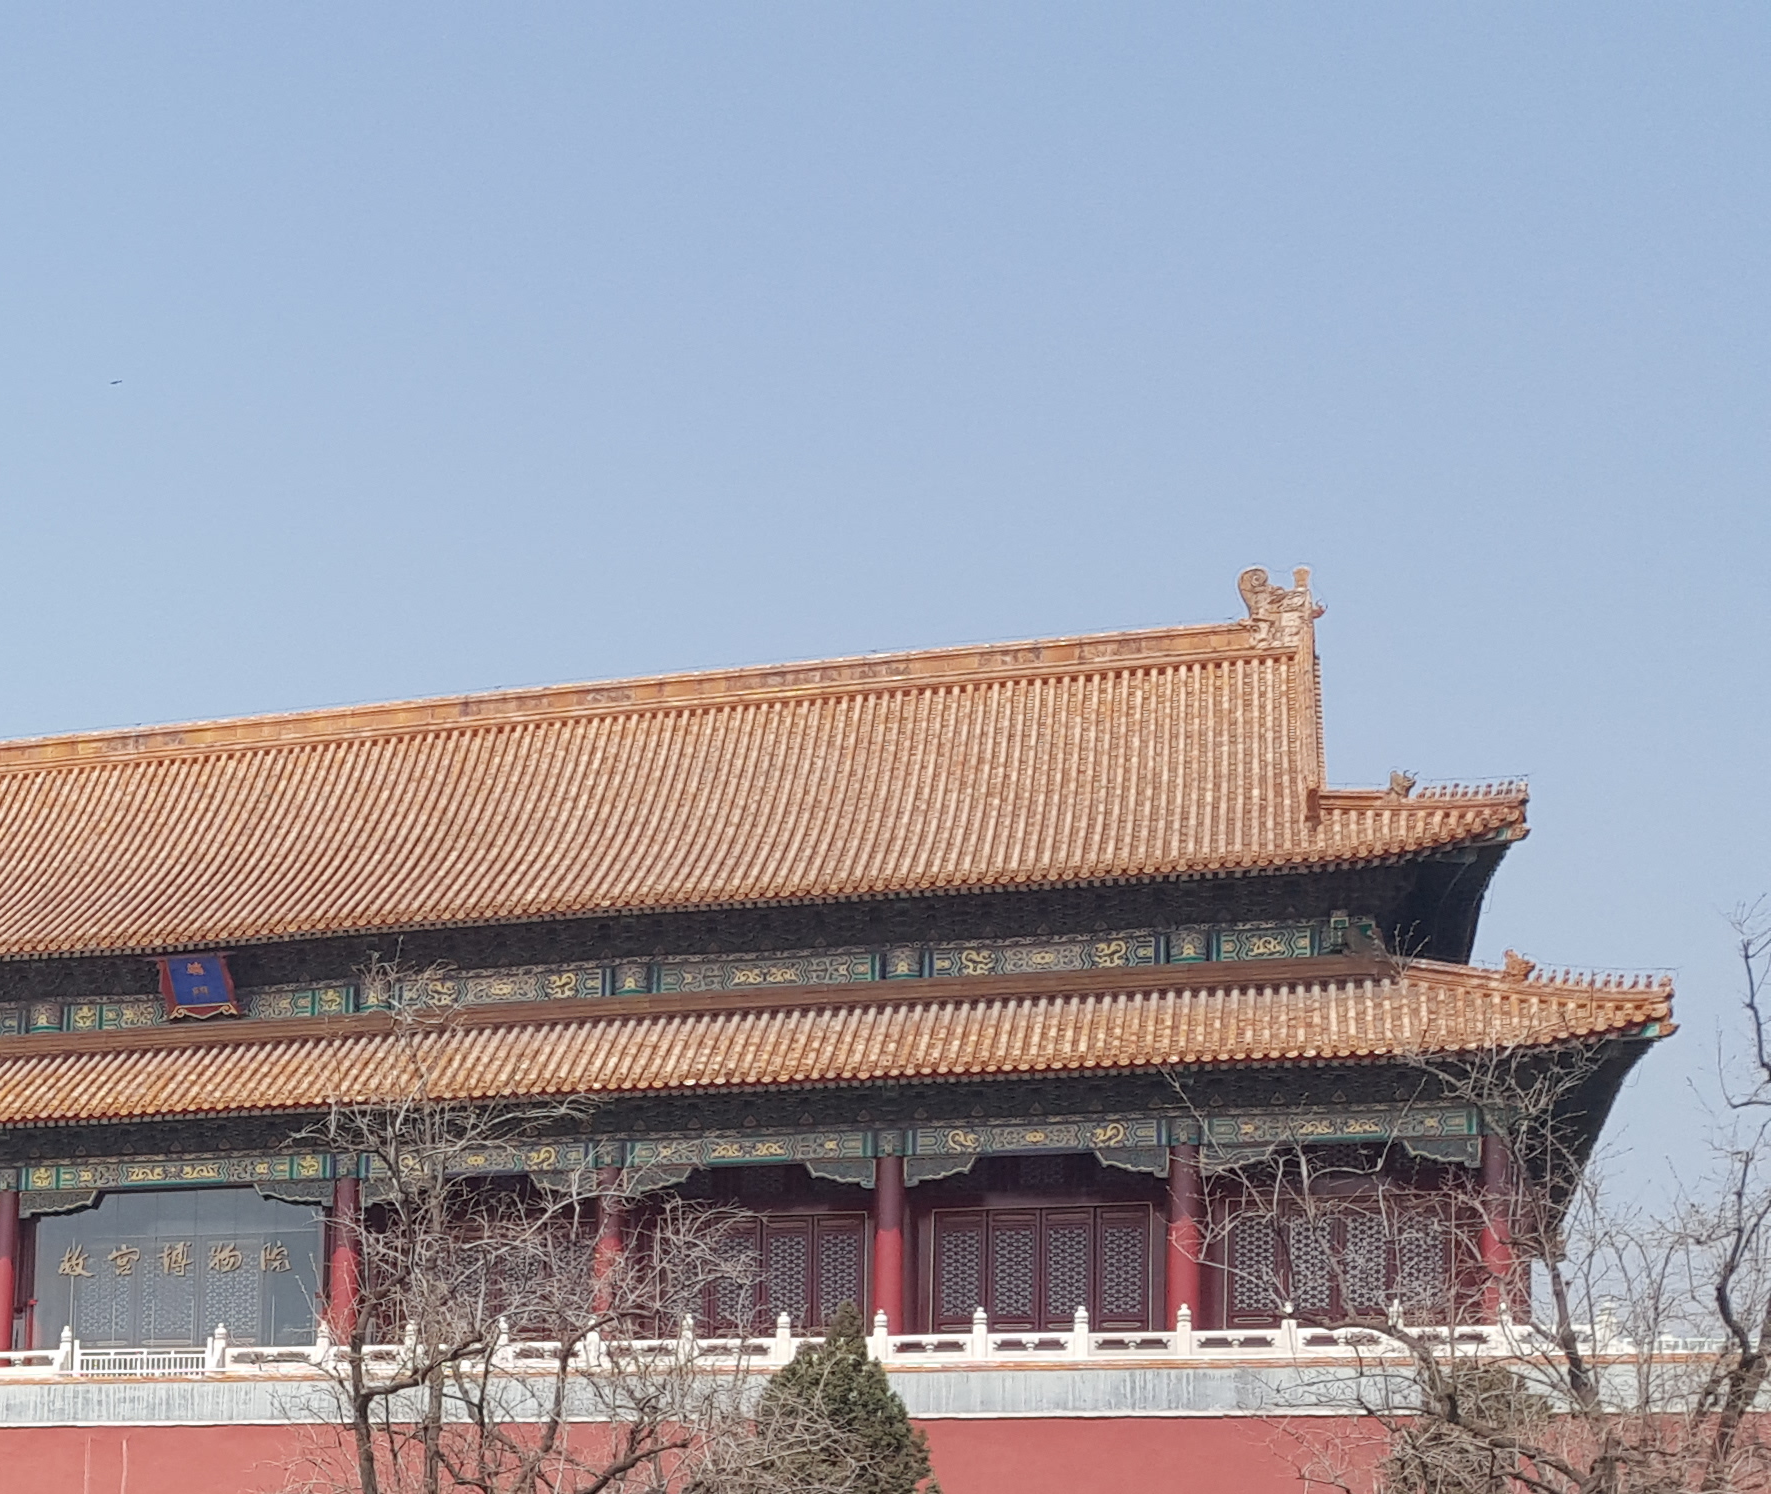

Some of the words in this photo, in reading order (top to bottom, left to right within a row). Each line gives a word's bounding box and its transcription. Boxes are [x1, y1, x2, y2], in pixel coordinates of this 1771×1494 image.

[57, 1241, 293, 1278] 故宫博物院
